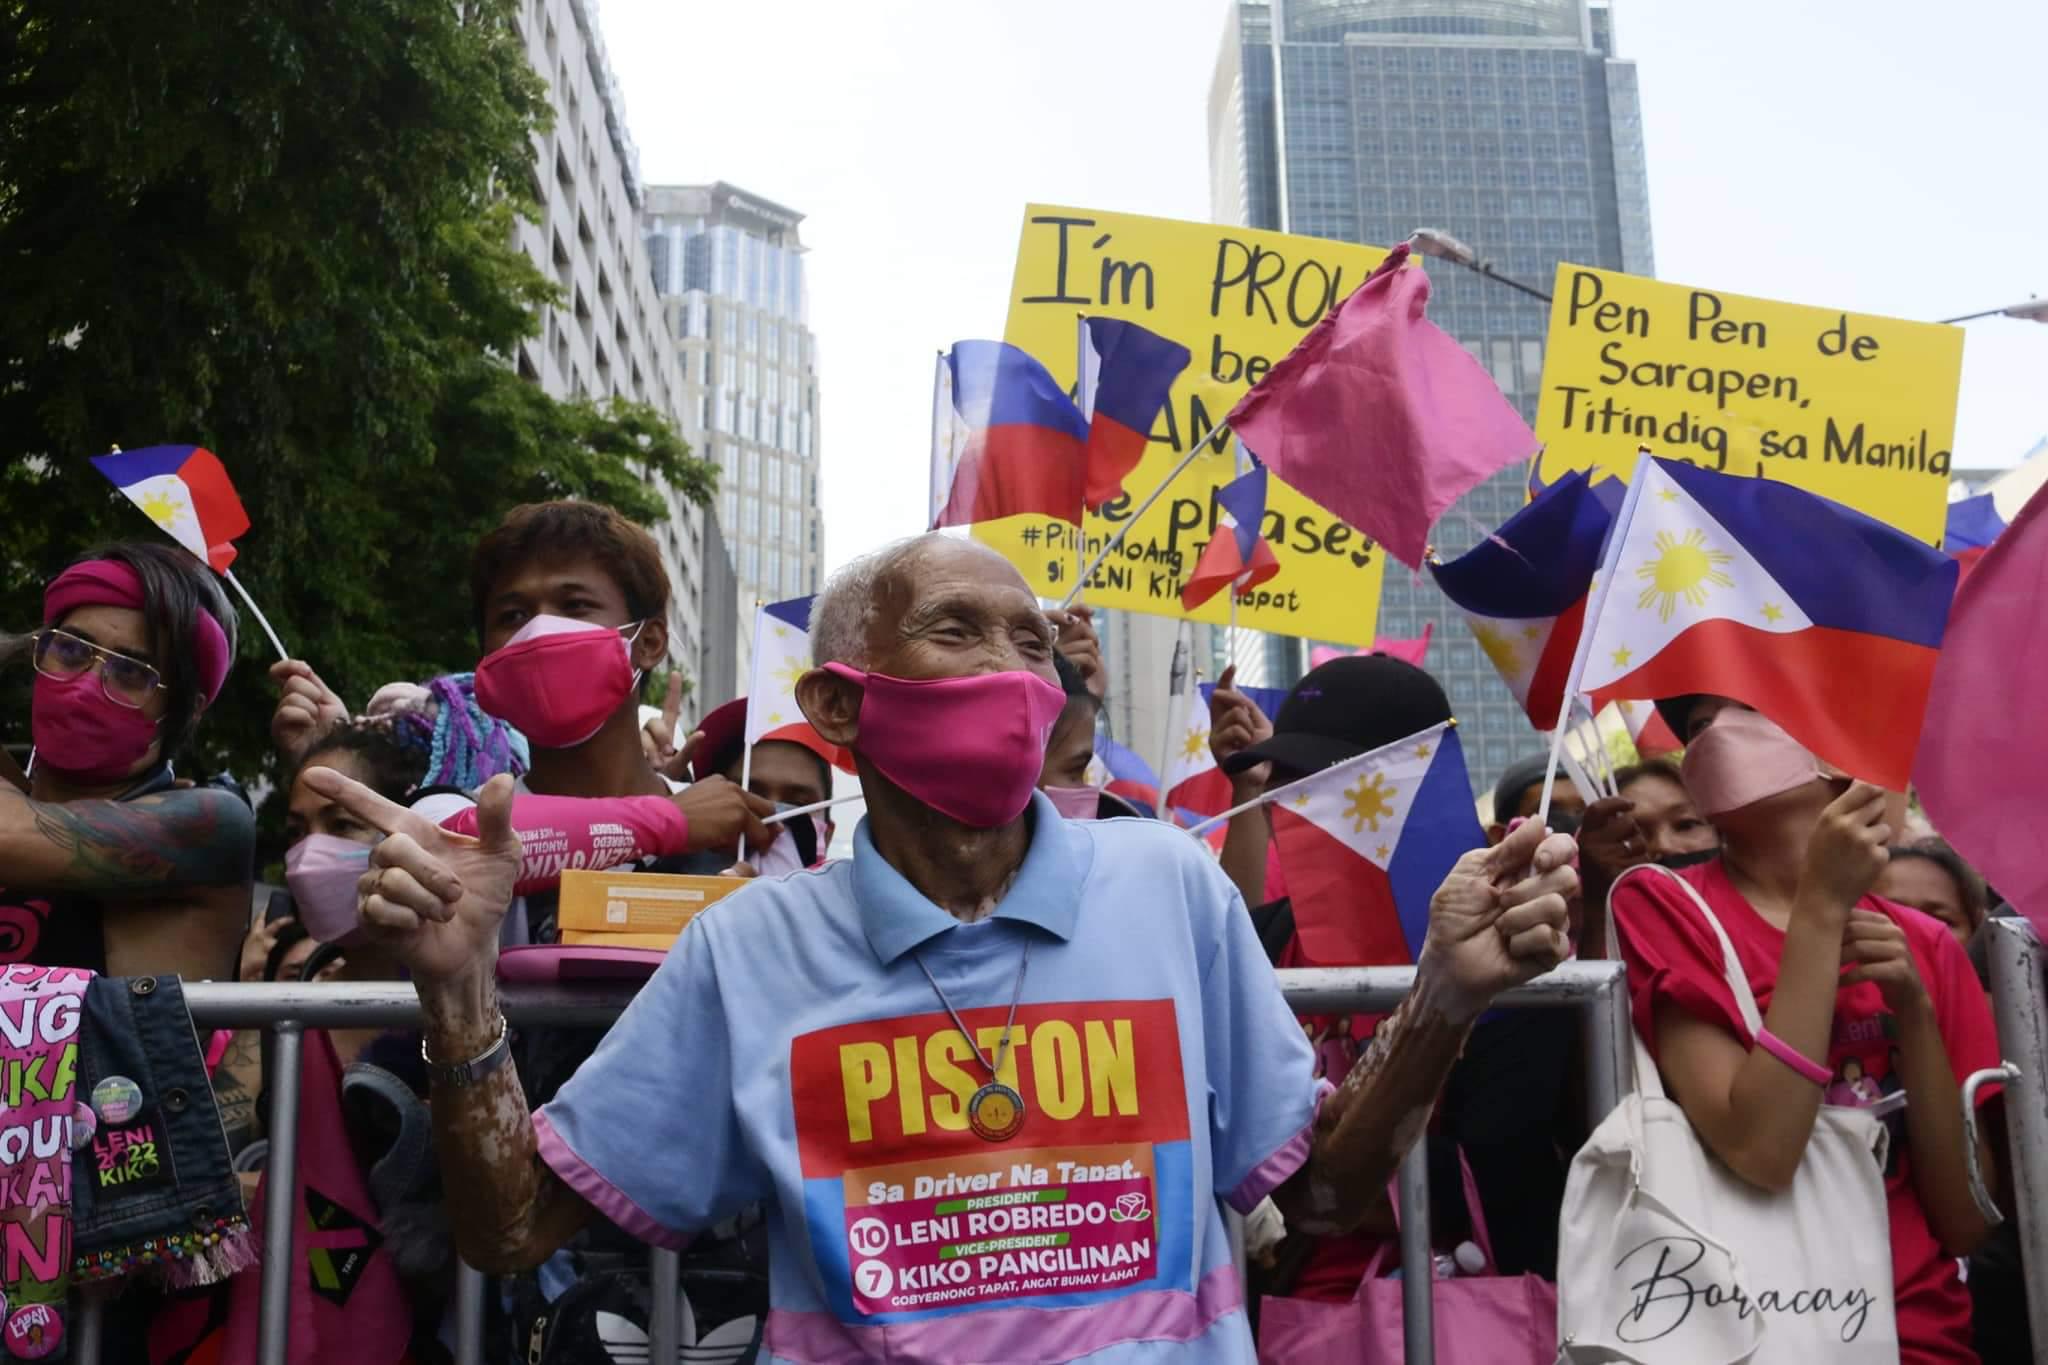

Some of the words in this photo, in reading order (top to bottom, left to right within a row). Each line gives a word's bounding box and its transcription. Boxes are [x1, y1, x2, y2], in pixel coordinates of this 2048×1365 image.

[1022, 216, 1154, 310] I'm
[1569, 271, 1650, 338] Pen
[1688, 292, 1767, 349] Pen
[1817, 314, 1880, 362] de
[1599, 341, 1810, 409] Sarapen,
[1554, 385, 1728, 473] Titindig
[1760, 429, 1808, 460] sa
[1823, 416, 1952, 478] Manila
[1149, 570, 1185, 599] KIK
[839, 1018, 1138, 1143] PISTON
[92, 1125, 153, 1152] LENI
[99, 1158, 160, 1187] KIKO
[867, 1182, 904, 1205] Sa
[914, 1169, 1001, 1200] Driver
[1010, 1164, 1048, 1187] Na
[967, 1191, 1039, 1210] PRESIDENT
[853, 1226, 888, 1249] 10
[894, 1219, 960, 1246] LENI
[969, 1201, 1106, 1236] ROBREDO
[955, 1234, 1057, 1256] VICE-PRESIDENT
[865, 1269, 883, 1292] 7
[899, 1260, 972, 1290] KIKO
[980, 1237, 1150, 1279] PANGILINAN
[891, 1286, 976, 1306] GOBYERNONG
[978, 1281, 1020, 1296] TAPAT,
[1022, 1277, 1059, 1290] ANGAT
[1060, 1273, 1099, 1287] BUHAY
[1101, 1267, 1140, 1283] LAHAT
[1614, 1235, 1878, 1343] Boracay
